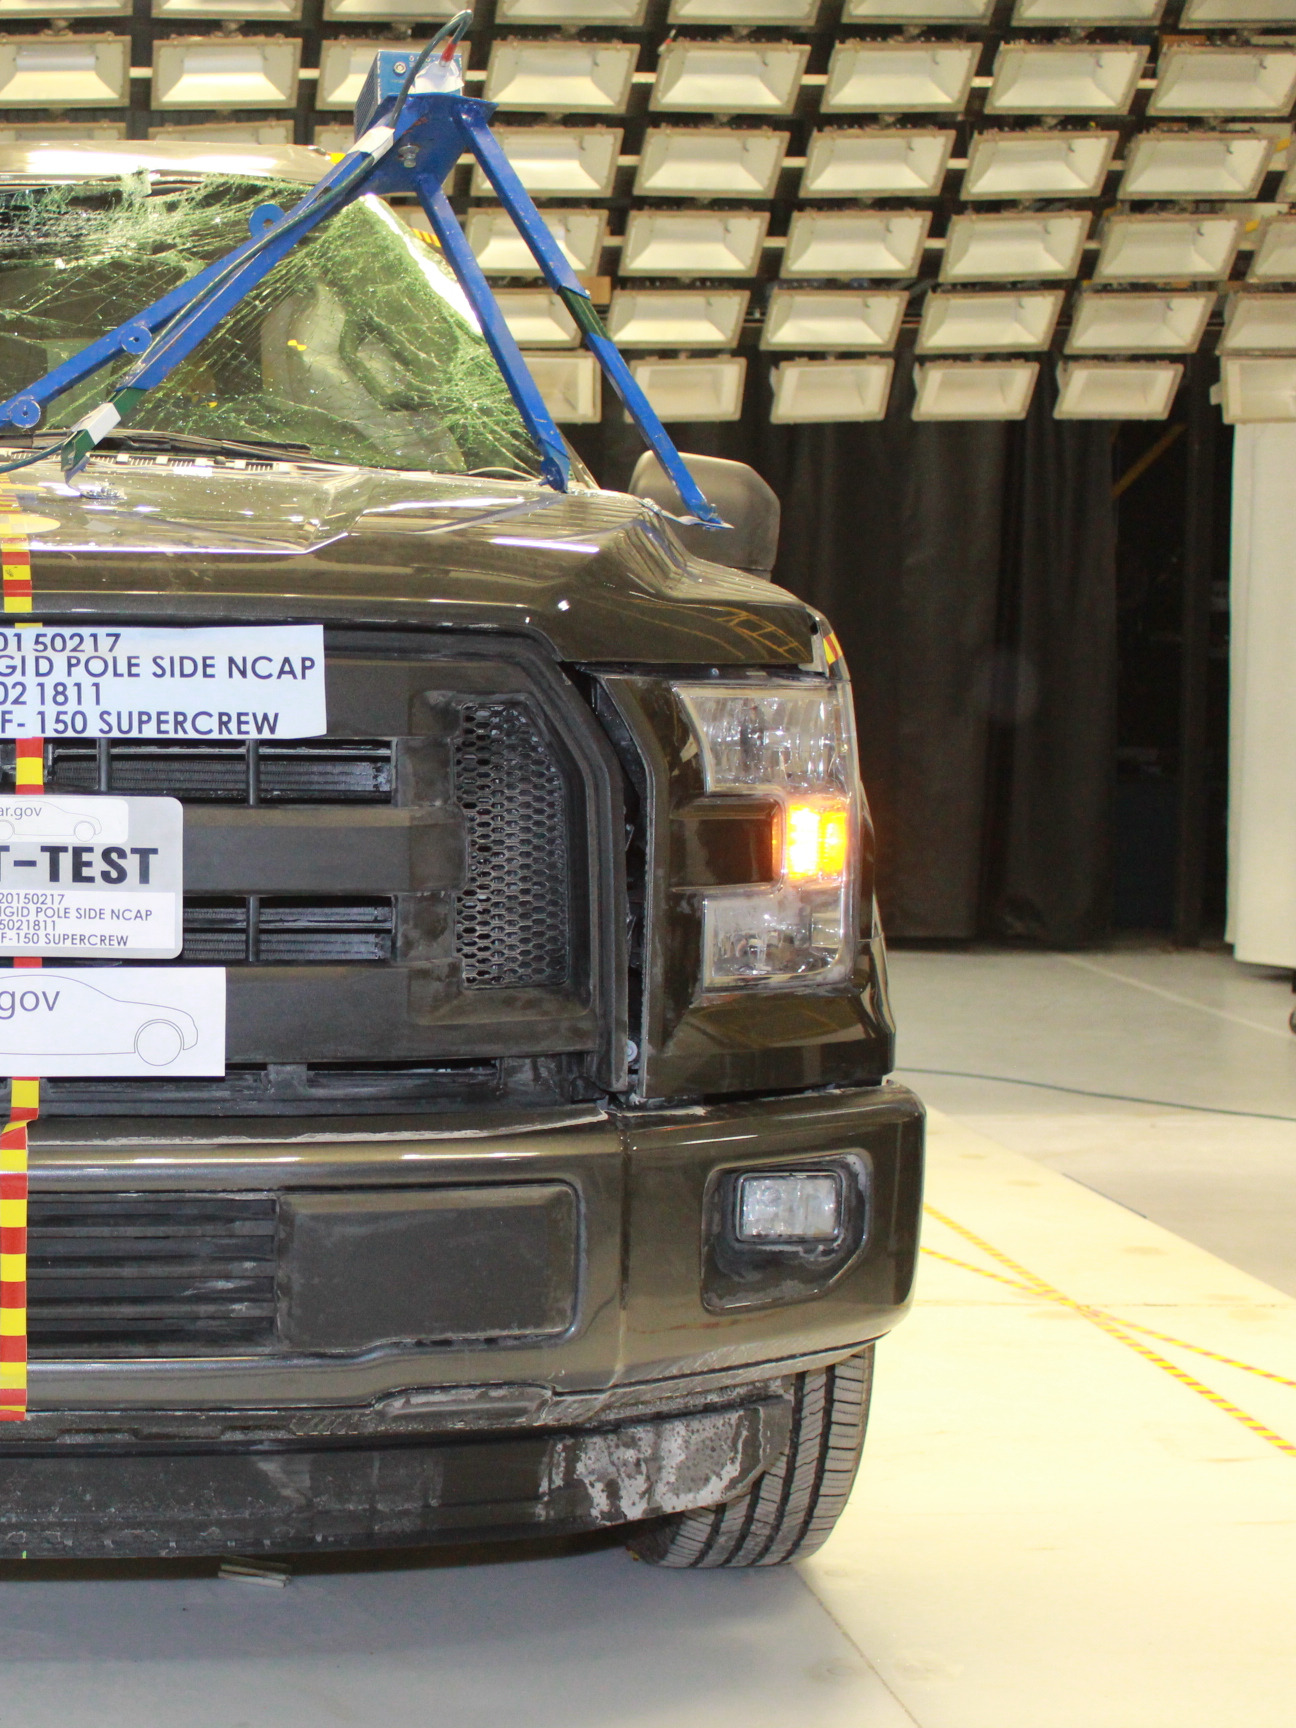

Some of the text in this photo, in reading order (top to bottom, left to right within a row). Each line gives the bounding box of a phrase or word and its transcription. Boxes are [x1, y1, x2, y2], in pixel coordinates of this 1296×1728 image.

[67, 656, 140, 678] POLE
[152, 656, 215, 679] SIDE
[228, 656, 315, 680] NCAP
[98, 712, 279, 735] SUPERCREW
[36, 907, 70, 919] POLE
[76, 908, 105, 920] SIDE
[111, 909, 152, 921] NCAP
[1, 933, 39, 944] F-150
[45, 934, 128, 947] SUPERCREW
